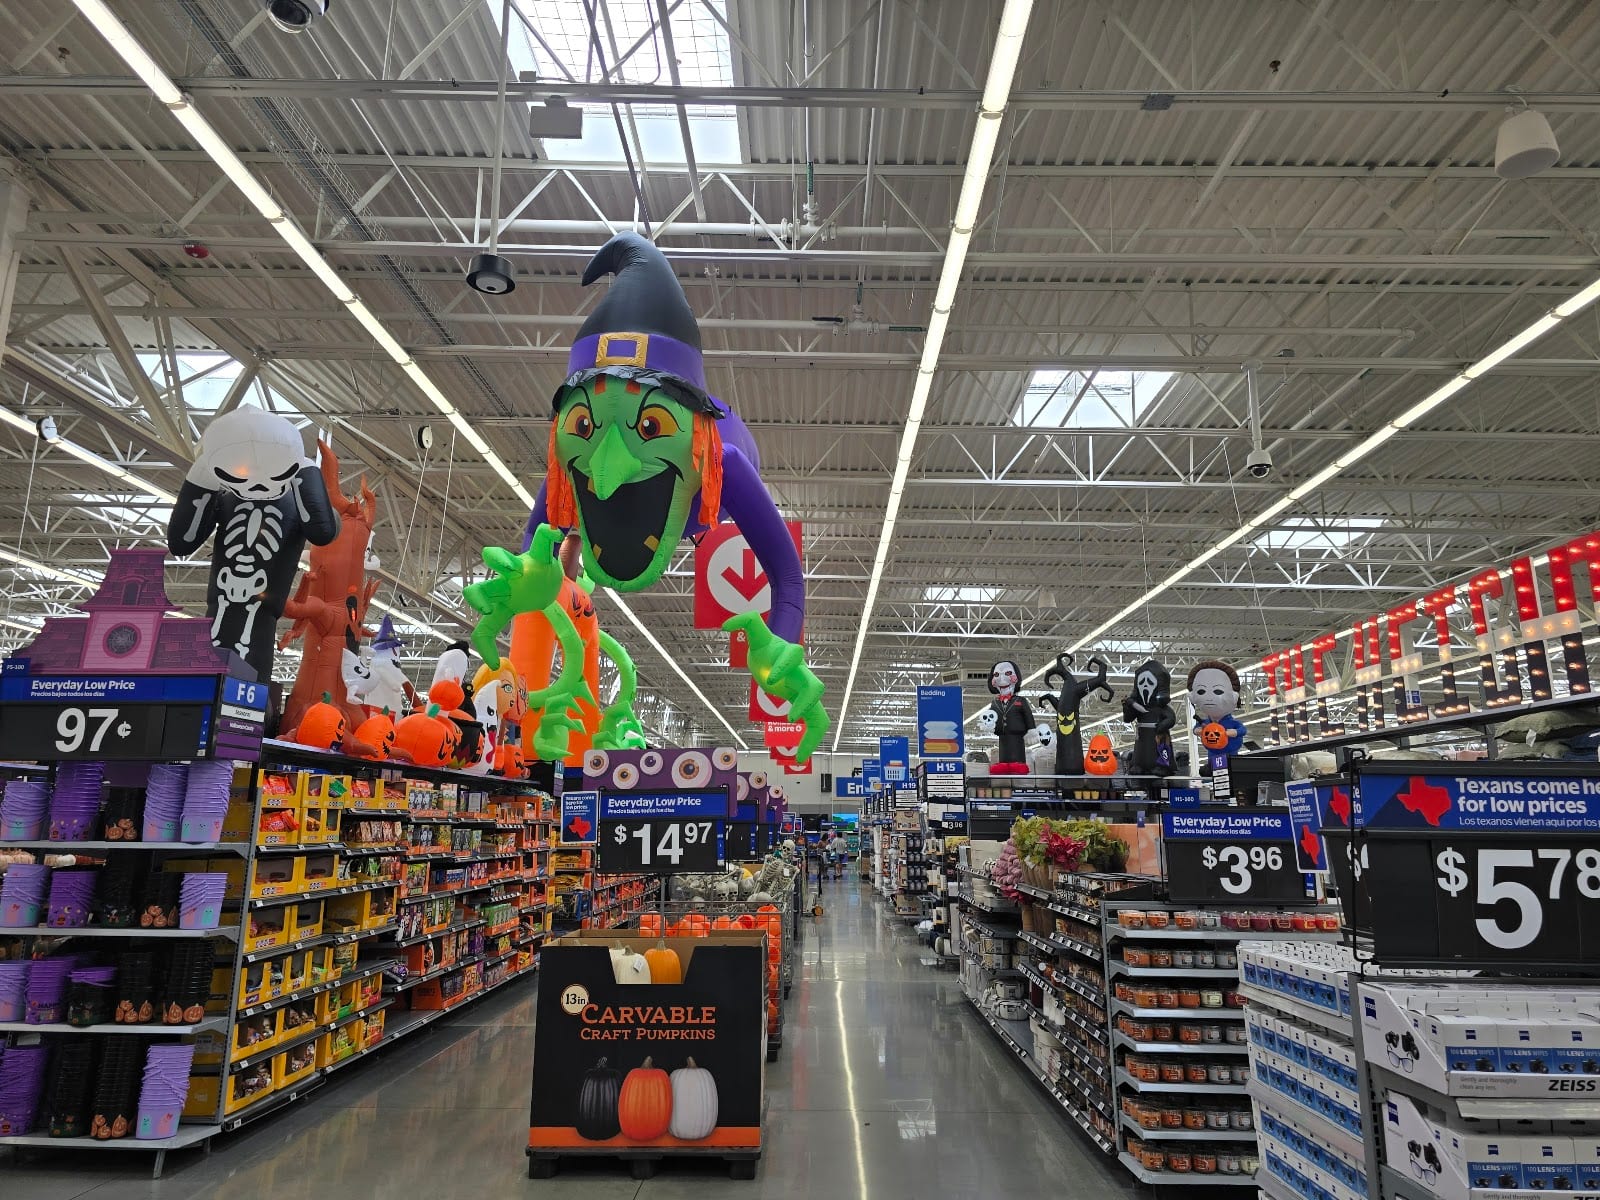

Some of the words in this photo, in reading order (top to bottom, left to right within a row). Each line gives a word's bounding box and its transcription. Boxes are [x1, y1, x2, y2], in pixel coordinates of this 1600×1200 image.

[32, 680, 83, 692] Everyday
[84, 680, 108, 690] Low
[108, 680, 136, 690] Price
[1455, 777, 1525, 794] Texans
[1527, 780, 1580, 794] come
[608, 797, 655, 808] Everyday
[656, 797, 676, 806] Low
[676, 796, 702, 806] Price
[1457, 796, 1488, 812] for
[1490, 796, 1524, 812] low
[1528, 796, 1588, 816] prices
[1172, 816, 1226, 828] Everyday
[1228, 816, 1252, 827] Low
[1253, 816, 1282, 828] Price
[1459, 817, 1476, 826] Los
[1476, 818, 1513, 826] texanos
[1513, 818, 1545, 826] vienen
[1566, 819, 1584, 828] por
[1584, 818, 1597, 826] los
[581, 1003, 716, 1024] CARVABLE
[580, 1028, 632, 1040] CRAFT
[636, 1028, 716, 1040] PUMPKINS
[1548, 1080, 1596, 1092] ZEISS
